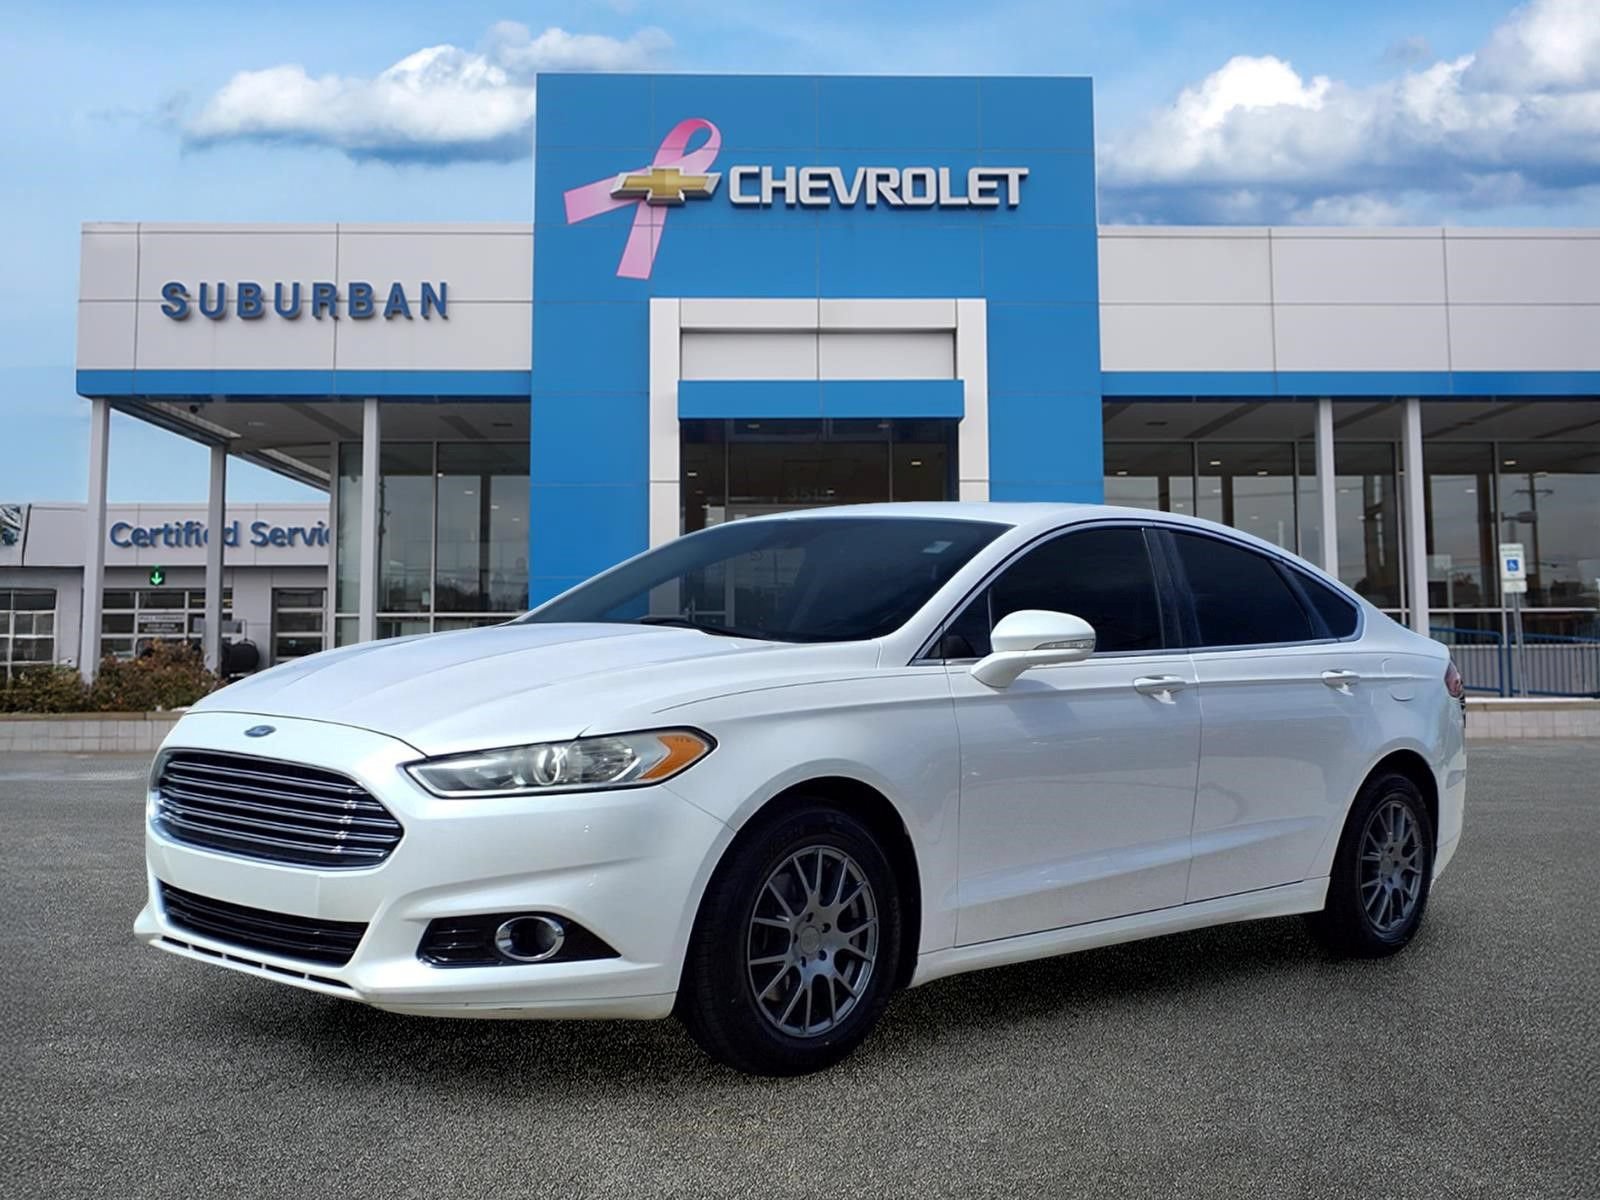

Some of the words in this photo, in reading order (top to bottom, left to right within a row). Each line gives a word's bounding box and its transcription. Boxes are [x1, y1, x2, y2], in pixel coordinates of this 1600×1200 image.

[729, 166, 1029, 206] CHEVROLET
[160, 282, 449, 320] SUBURBAN
[110, 521, 240, 547] Certifid
[250, 521, 330, 547] Servi
